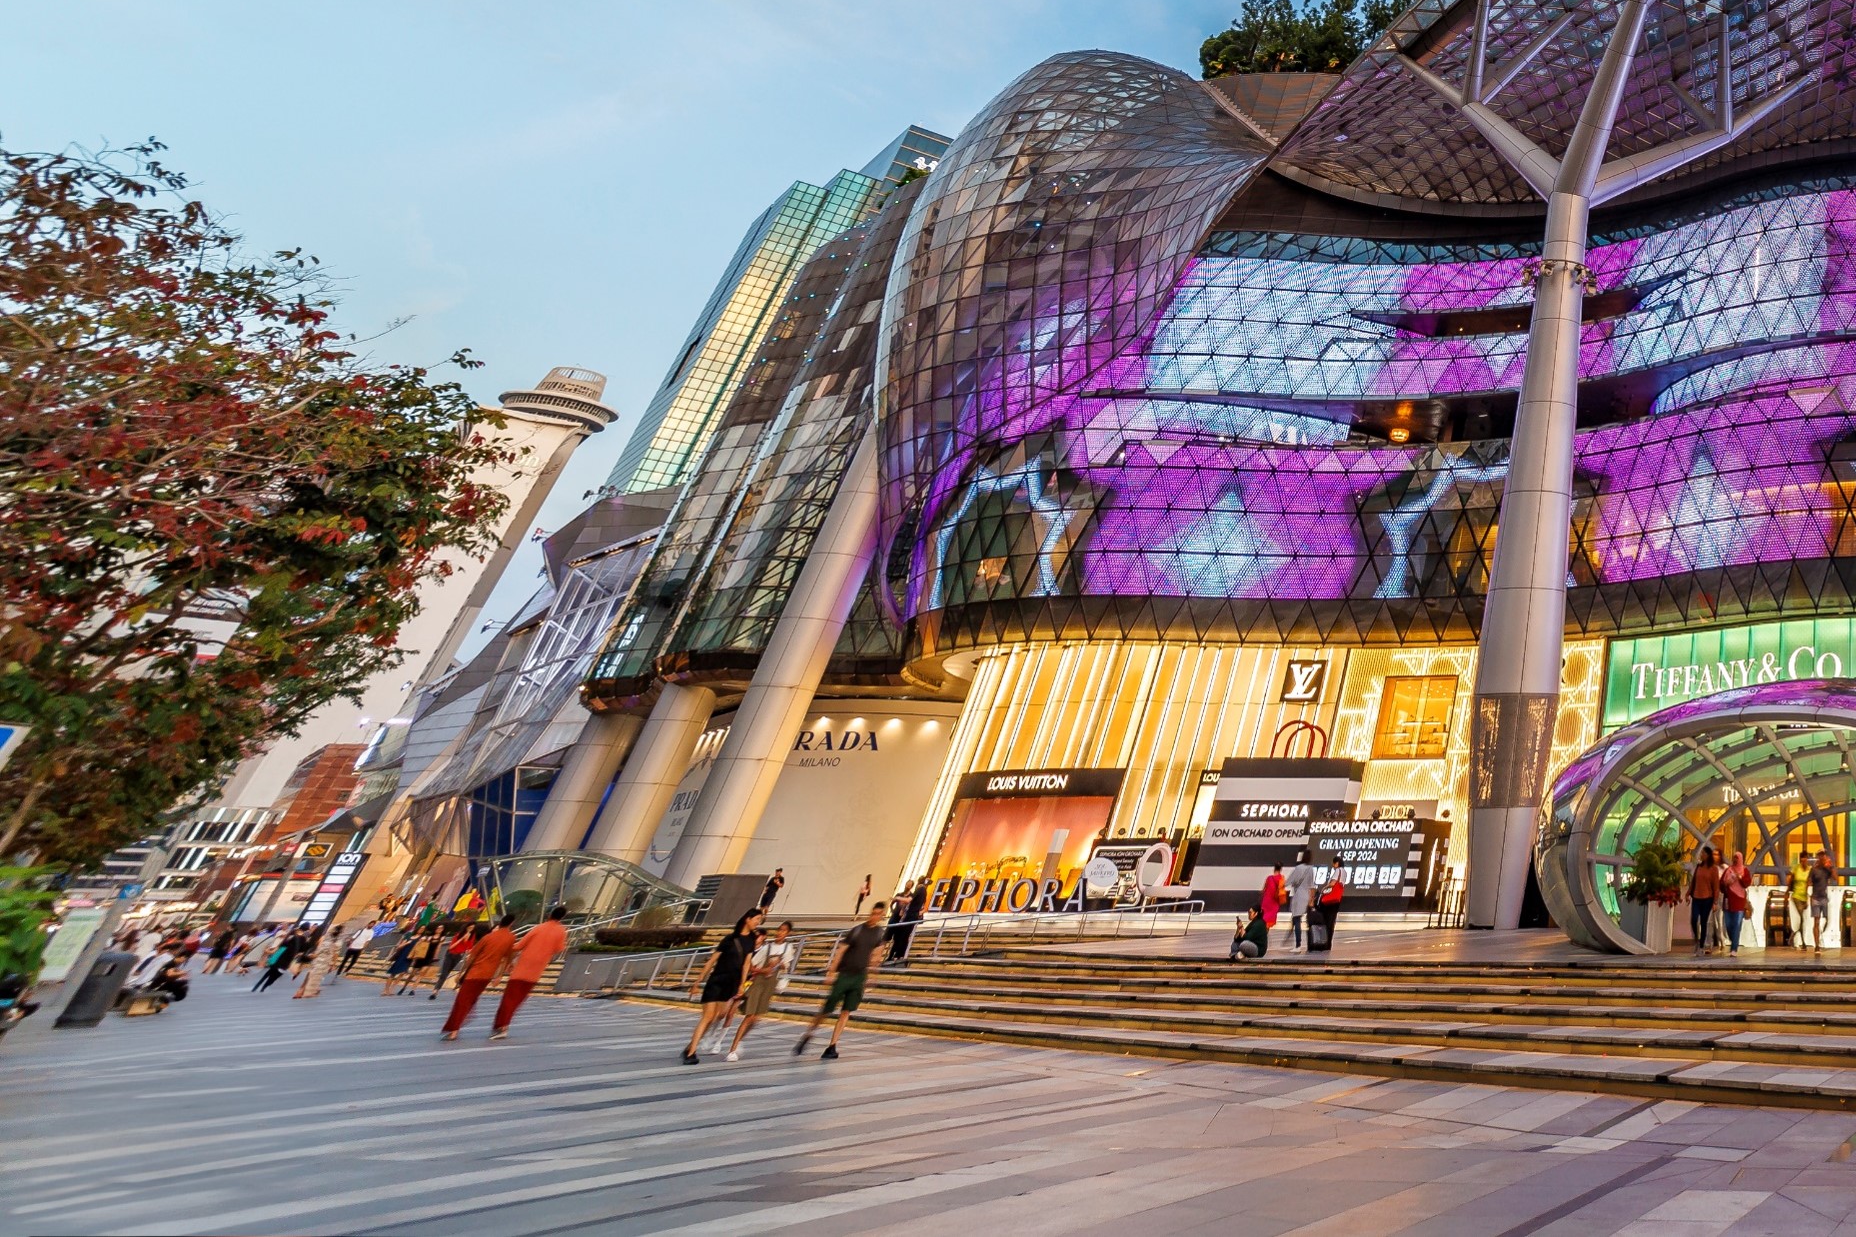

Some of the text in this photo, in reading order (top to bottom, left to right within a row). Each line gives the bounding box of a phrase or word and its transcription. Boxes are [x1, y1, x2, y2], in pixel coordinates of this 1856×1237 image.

[1632, 657, 1755, 700] TIFFANY
[792, 730, 879, 751] RADA
[798, 757, 841, 768] MILANO
[987, 774, 1069, 791] LOUIS VUITTON
[1203, 772, 1221, 782] LOU
[669, 789, 699, 813] PRAD
[1240, 803, 1309, 818] SEPHORA
[1211, 828, 1304, 839] ION ORCHARD OPENS
[1310, 820, 1414, 833] SEPHORA ION ORCHARD
[1319, 838, 1399, 850] GRAND OPENING
[1343, 851, 1356, 861] SEP
[1357, 851, 1377, 861] 2024
[926, 877, 1087, 912] EPHORA
